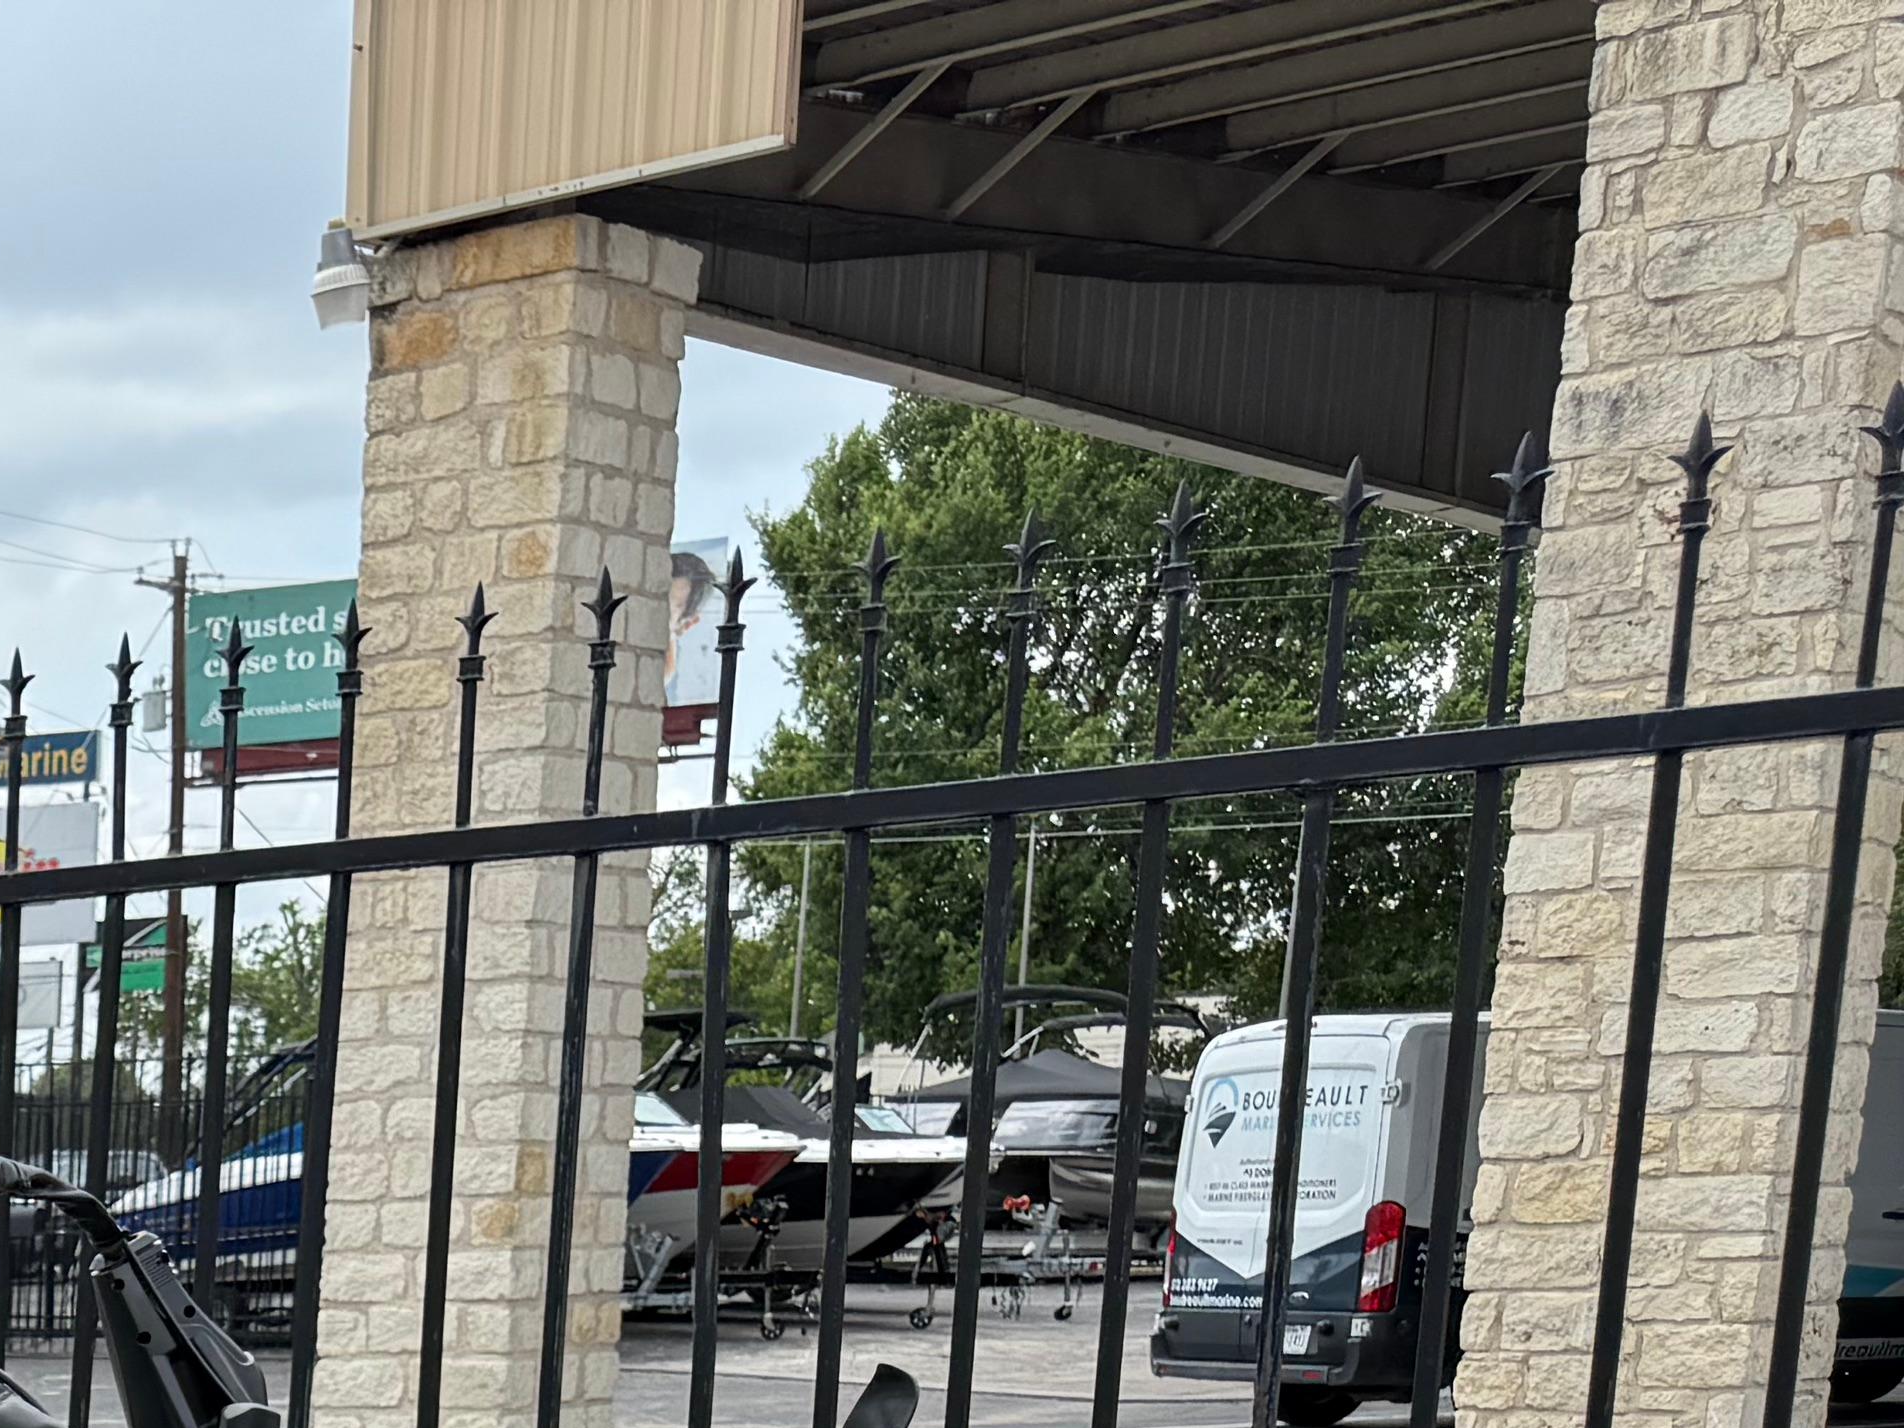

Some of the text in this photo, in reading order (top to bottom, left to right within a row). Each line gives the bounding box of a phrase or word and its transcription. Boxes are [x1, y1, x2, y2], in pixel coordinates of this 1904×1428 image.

[205, 606, 326, 642] Tusted
[203, 652, 277, 678] clse
[285, 648, 315, 671] to
[1242, 1085, 1369, 1111] BOUEAULT
[1241, 1111, 1361, 1131] MARI RVICES
